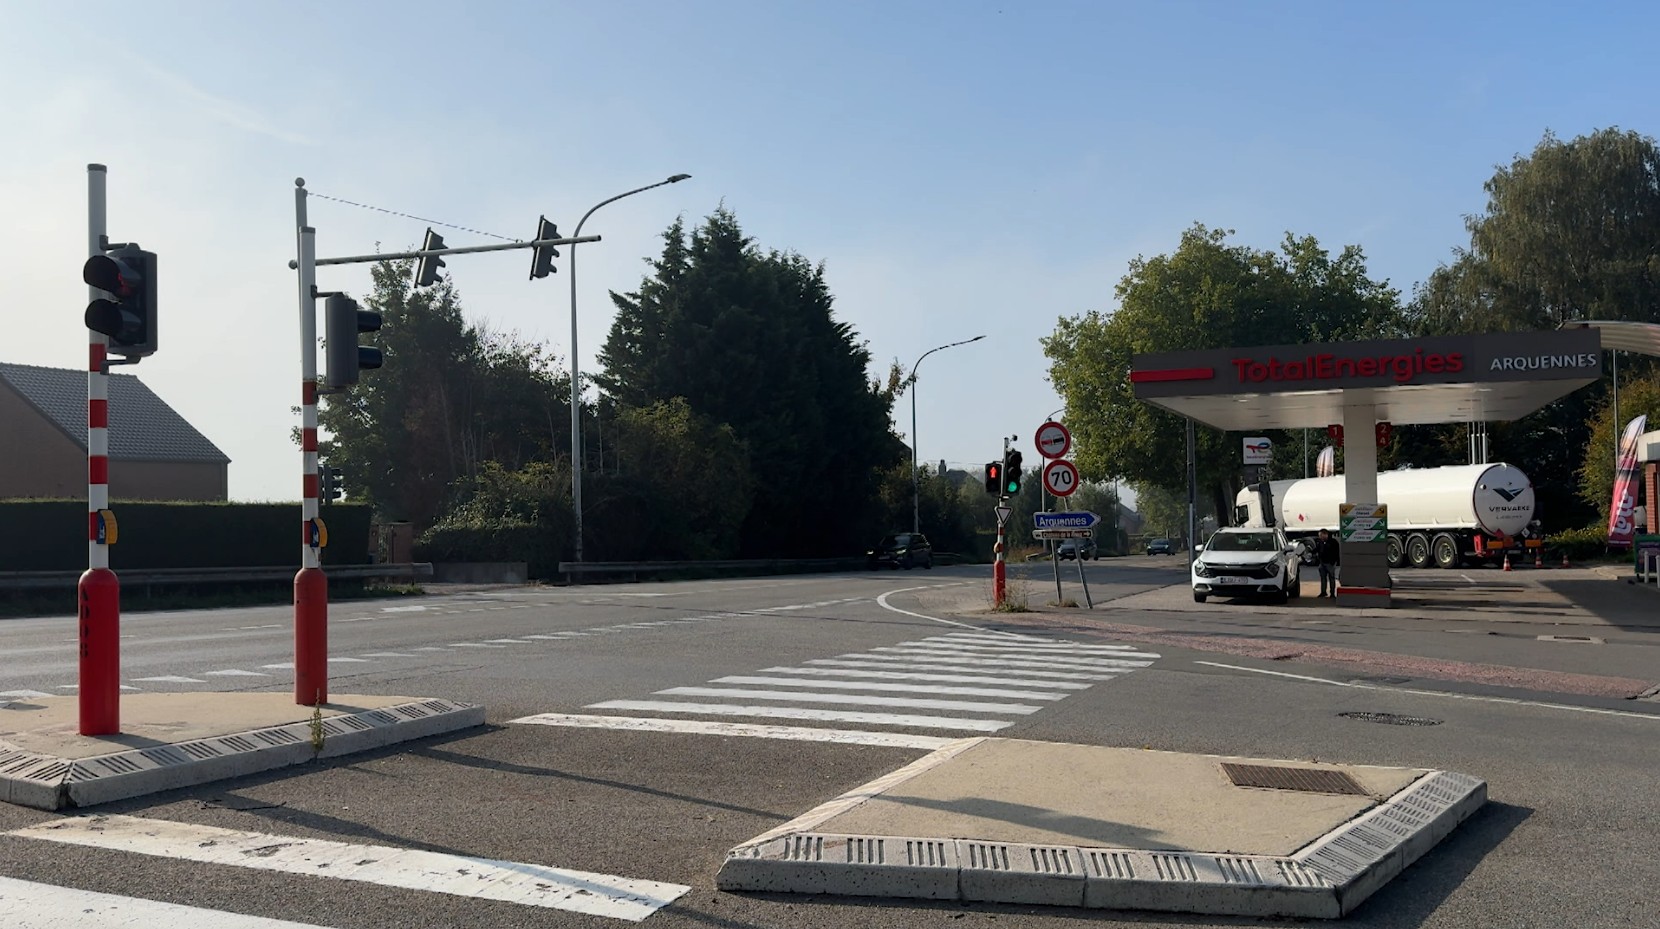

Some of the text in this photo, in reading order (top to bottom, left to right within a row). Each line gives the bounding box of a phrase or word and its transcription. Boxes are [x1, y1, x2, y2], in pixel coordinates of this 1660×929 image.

[1232, 348, 1464, 383] TotalEnergies
[1490, 354, 1597, 371] ARQUENNES
[1380, 424, 1387, 433] 2
[1051, 470, 1072, 487] 70
[1039, 516, 1087, 528] Arquennes
